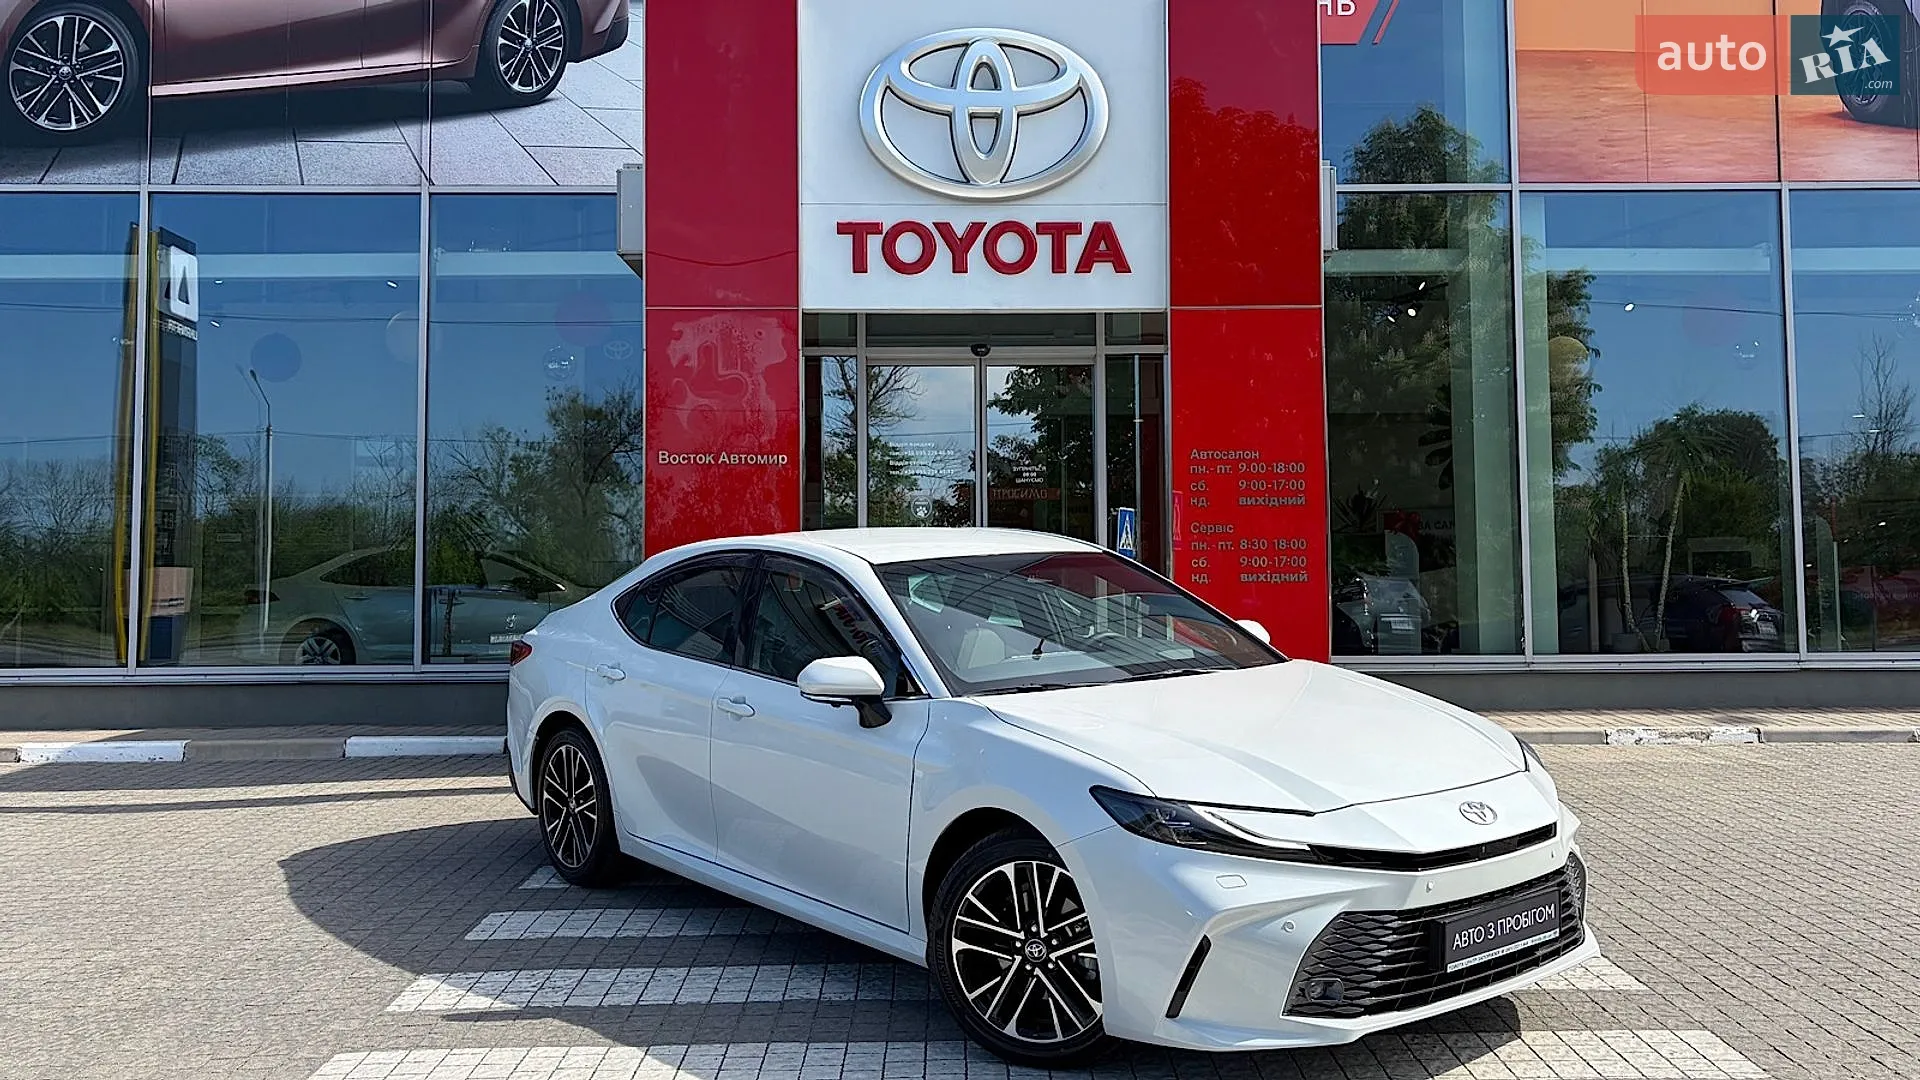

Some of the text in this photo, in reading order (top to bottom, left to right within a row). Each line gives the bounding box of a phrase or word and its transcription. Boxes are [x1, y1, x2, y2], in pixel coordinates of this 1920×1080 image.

[836, 220, 1133, 275] TOYOTA
[658, 450, 788, 467] Восток Автомир
[1190, 449, 1260, 460] Автосалон
[1190, 480, 1306, 491] сб. 9:00-17:00
[1190, 494, 1306, 507] нд. вихідний
[1190, 522, 1234, 535] Сервіс
[1191, 556, 1307, 568] сб. 9:00-17:00
[1191, 570, 1308, 584] нд. вихідний
[1452, 926, 1485, 951] АВТО
[1487, 922, 1496, 940] З
[1497, 903, 1556, 937] ПРОБІГОМ
